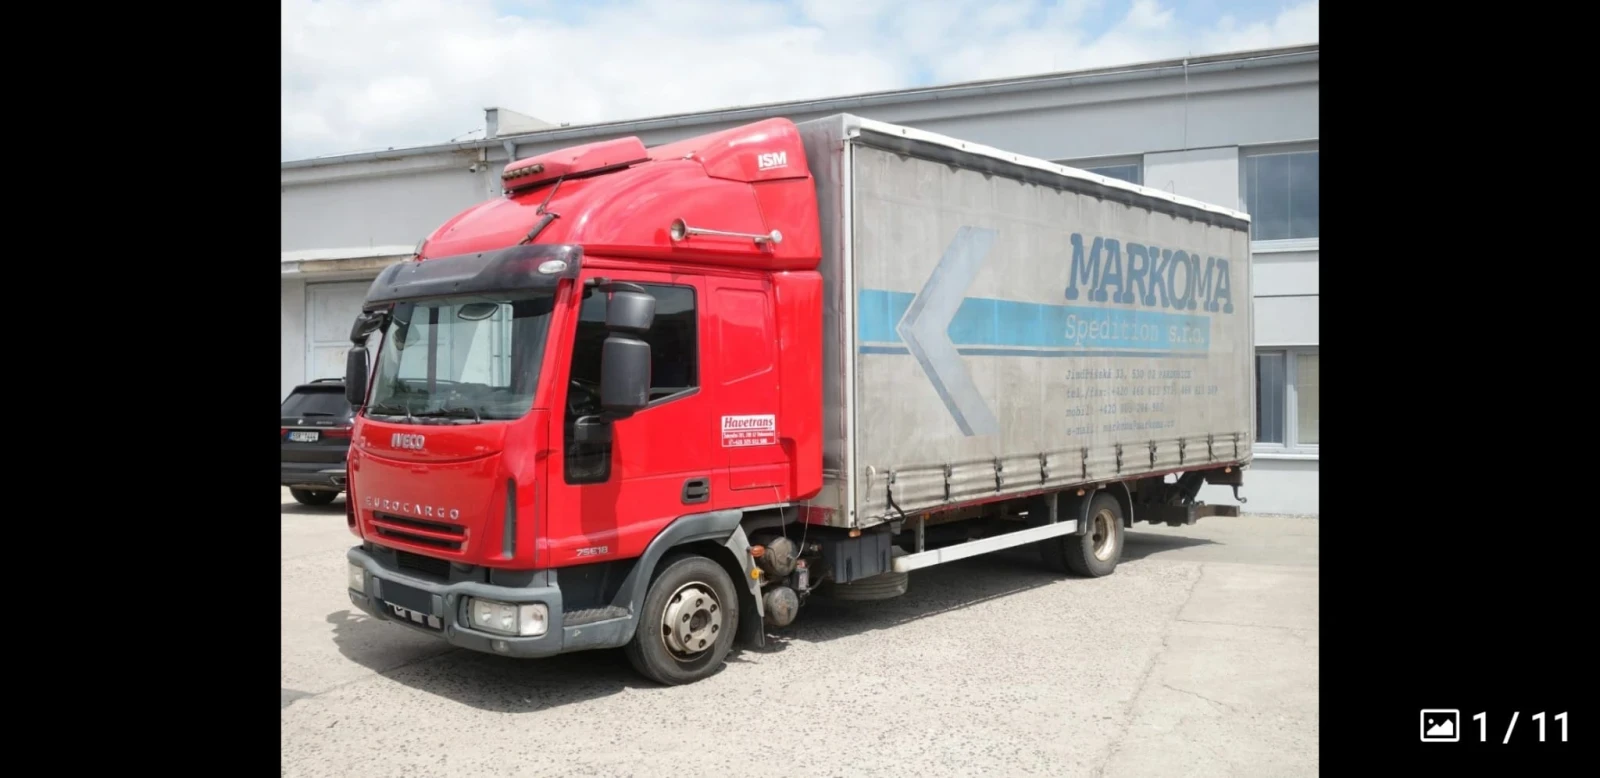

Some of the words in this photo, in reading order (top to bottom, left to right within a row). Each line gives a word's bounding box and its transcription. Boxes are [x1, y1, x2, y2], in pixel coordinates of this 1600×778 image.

[758, 151, 787, 168] ISM
[1065, 233, 1234, 314] MARKOMA
[1065, 314, 1159, 346] Spedition
[1169, 325, 1205, 344] s.r.o.
[724, 417, 773, 428] Havetrans
[391, 433, 425, 449] IVECO
[366, 496, 459, 519] EUROCARGO
